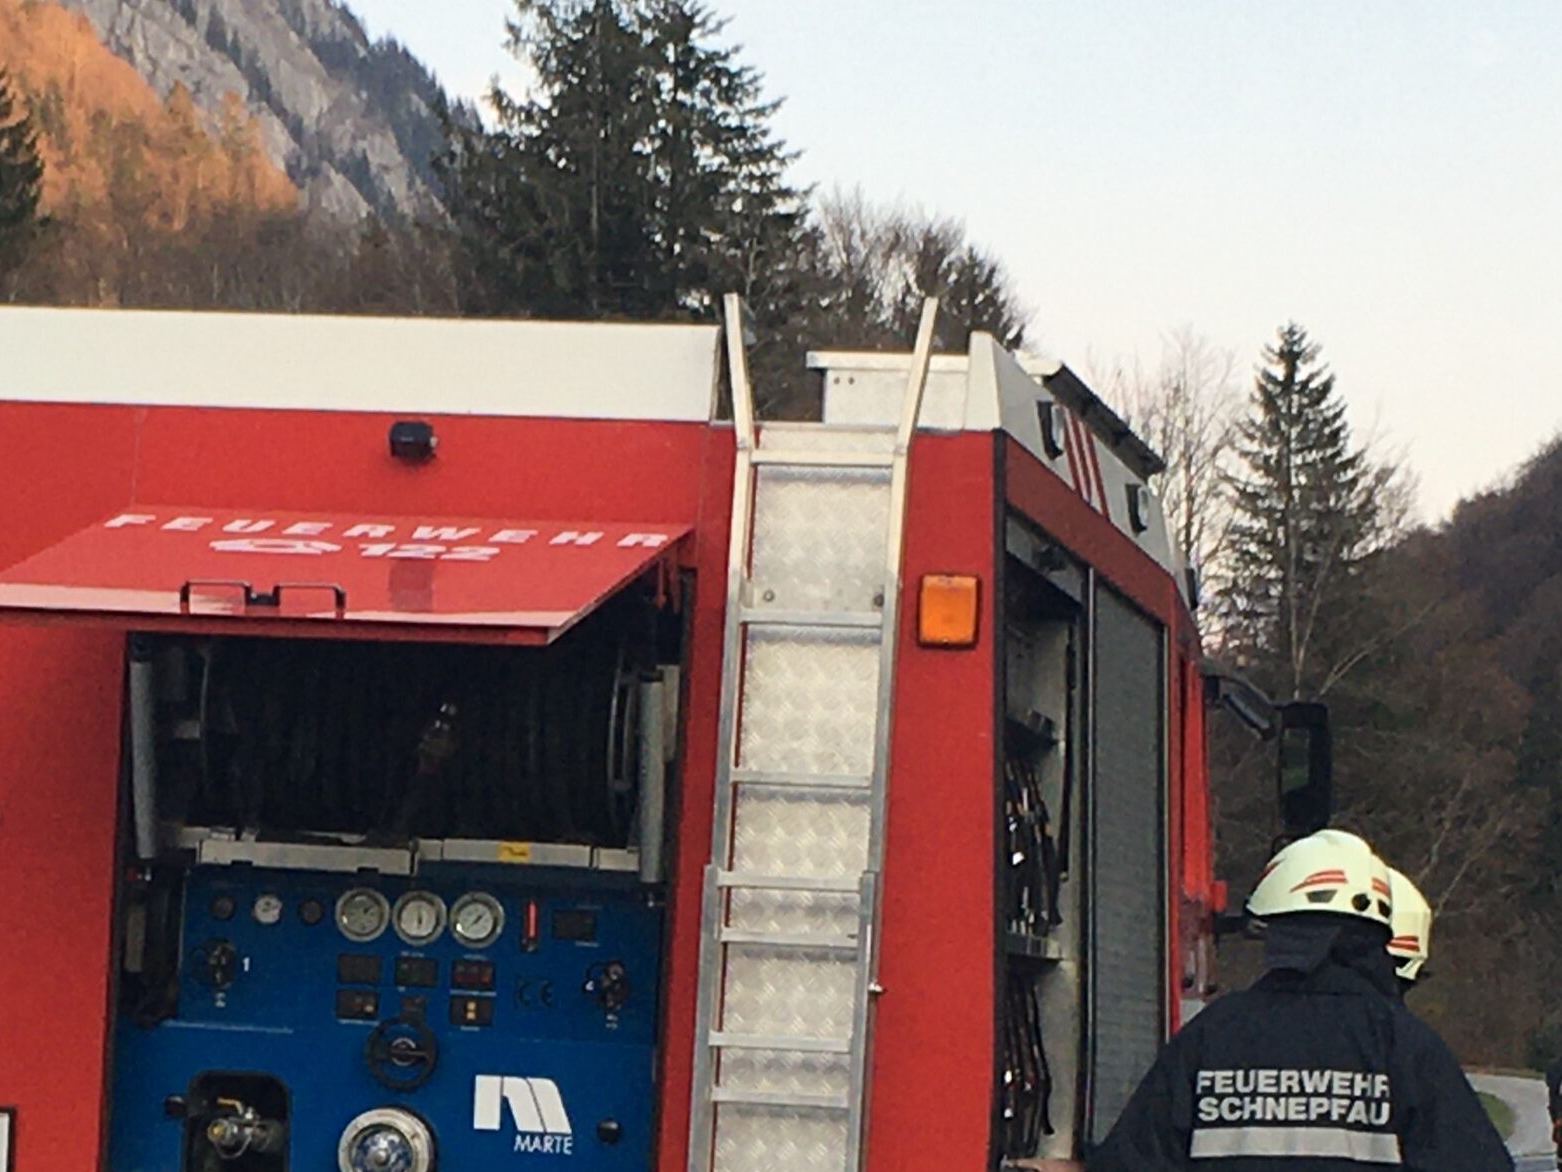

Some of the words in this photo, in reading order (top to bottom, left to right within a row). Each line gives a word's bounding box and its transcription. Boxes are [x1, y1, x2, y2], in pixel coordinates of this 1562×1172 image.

[104, 514, 668, 547] FEUERWEHR
[359, 542, 501, 561] 122
[1196, 1069, 1389, 1098] FEUERWEHR
[1198, 1096, 1389, 1125] SCHNEPFAU
[513, 1134, 573, 1156] MARTE
